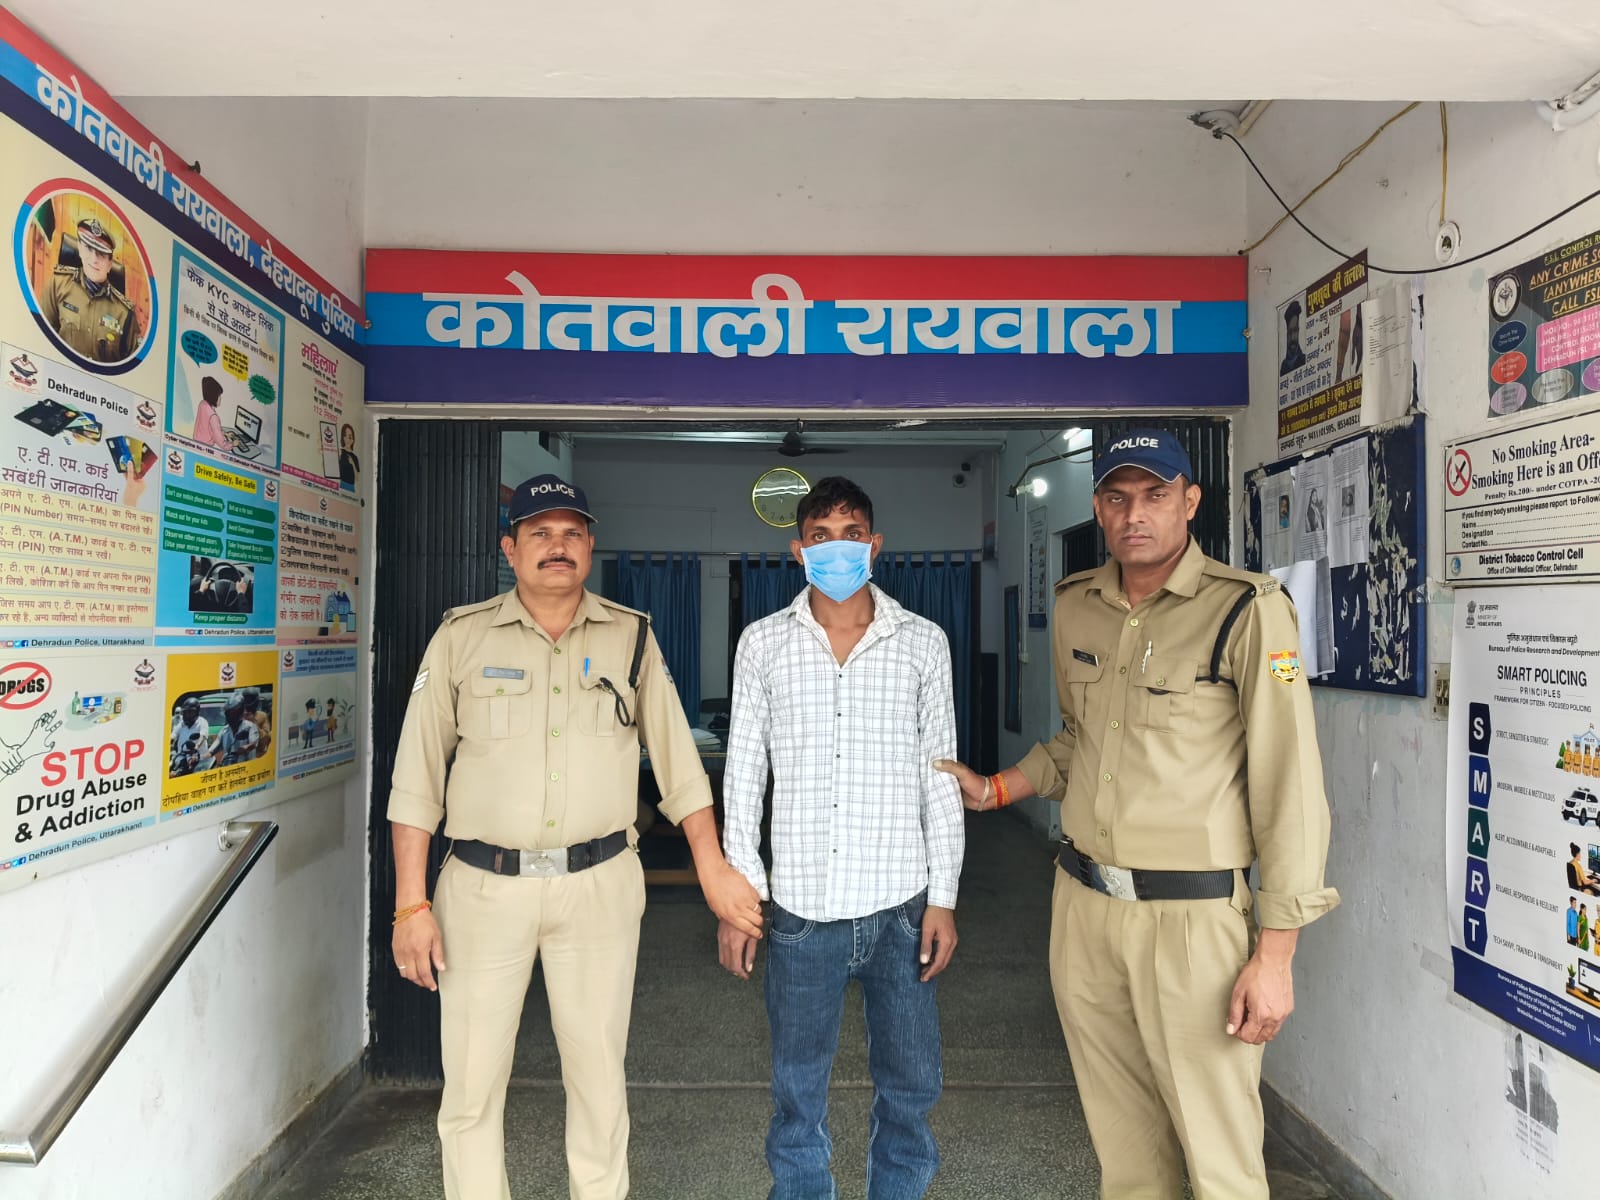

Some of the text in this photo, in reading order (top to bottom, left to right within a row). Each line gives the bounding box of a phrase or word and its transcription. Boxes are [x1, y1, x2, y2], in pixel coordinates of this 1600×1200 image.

[36, 63, 165, 195] कोतवाली
[171, 173, 255, 267] रायवाला,
[260, 239, 319, 319] देहरादून
[320, 292, 356, 340] पुलिस
[1560, 238, 1593, 257] CONTROL
[1529, 252, 1590, 288] ANY CRIME
[208, 281, 229, 305] KYC
[232, 299, 256, 321] अपडेट
[1307, 283, 1331, 315] गुमशुदा
[1332, 272, 1342, 294] की
[1551, 294, 1579, 315] CALL
[207, 300, 216, 316] से
[423, 270, 1181, 358] कोतवाली रायवाला
[301, 342, 339, 378] महिलाएं
[47, 378, 129, 416] Dehradun Police
[1110, 436, 1159, 453] POLICE
[1492, 433, 1595, 465] No Smoking Area-
[17, 446, 110, 480] ए. टी. एम. कार्ड
[1471, 449, 1600, 490] Smoking Here is an Off
[1, 465, 119, 503] संबंधी जानकारियां
[195, 464, 256, 490] Drive Safely, Be Safe
[1485, 490, 1506, 501] Penalty
[1536, 482, 1556, 493] under
[1558, 477, 1588, 490] COTPA
[530, 483, 576, 499] POLICE
[0, 502, 21, 514] (PIN
[24, 506, 63, 521] Number)
[1506, 503, 1530, 515] smoking
[1530, 501, 1549, 513] please
[1549, 499, 1568, 510] report
[1570, 496, 1578, 506] to
[1461, 520, 1477, 529] Name
[1461, 529, 1494, 540] Designation
[18, 541, 46, 554] (PIN)
[1461, 540, 1480, 549] Contact
[1478, 547, 1584, 566] District Tobacco Control Cell
[1553, 562, 1578, 572] Dehradun
[31, 637, 145, 647] Dehradun Police, Uttarakhand
[204, 628, 230, 636] Dehradun
[1511, 645, 1526, 654] Police
[1526, 646, 1551, 655] Research
[1551, 647, 1562, 655] and
[1497, 664, 1588, 687] SMART POLICING
[1493, 694, 1520, 705] FRAMEWORK
[1519, 695, 1529, 705] FOR
[1548, 699, 1570, 711] FOCUSED
[1569, 702, 1592, 713] POLICING
[1519, 686, 1562, 699] PRINCIPLES
[1473, 716, 1485, 741] S
[40, 739, 145, 787] STOP
[17, 772, 147, 816] Drug Abuse
[1473, 769, 1487, 796] M
[14, 796, 145, 844] & Addiction
[28, 821, 143, 862] Dehradun Police, Uttarakhand
[1471, 821, 1485, 847] A
[1471, 870, 1484, 896] R
[1468, 918, 1480, 943] T
